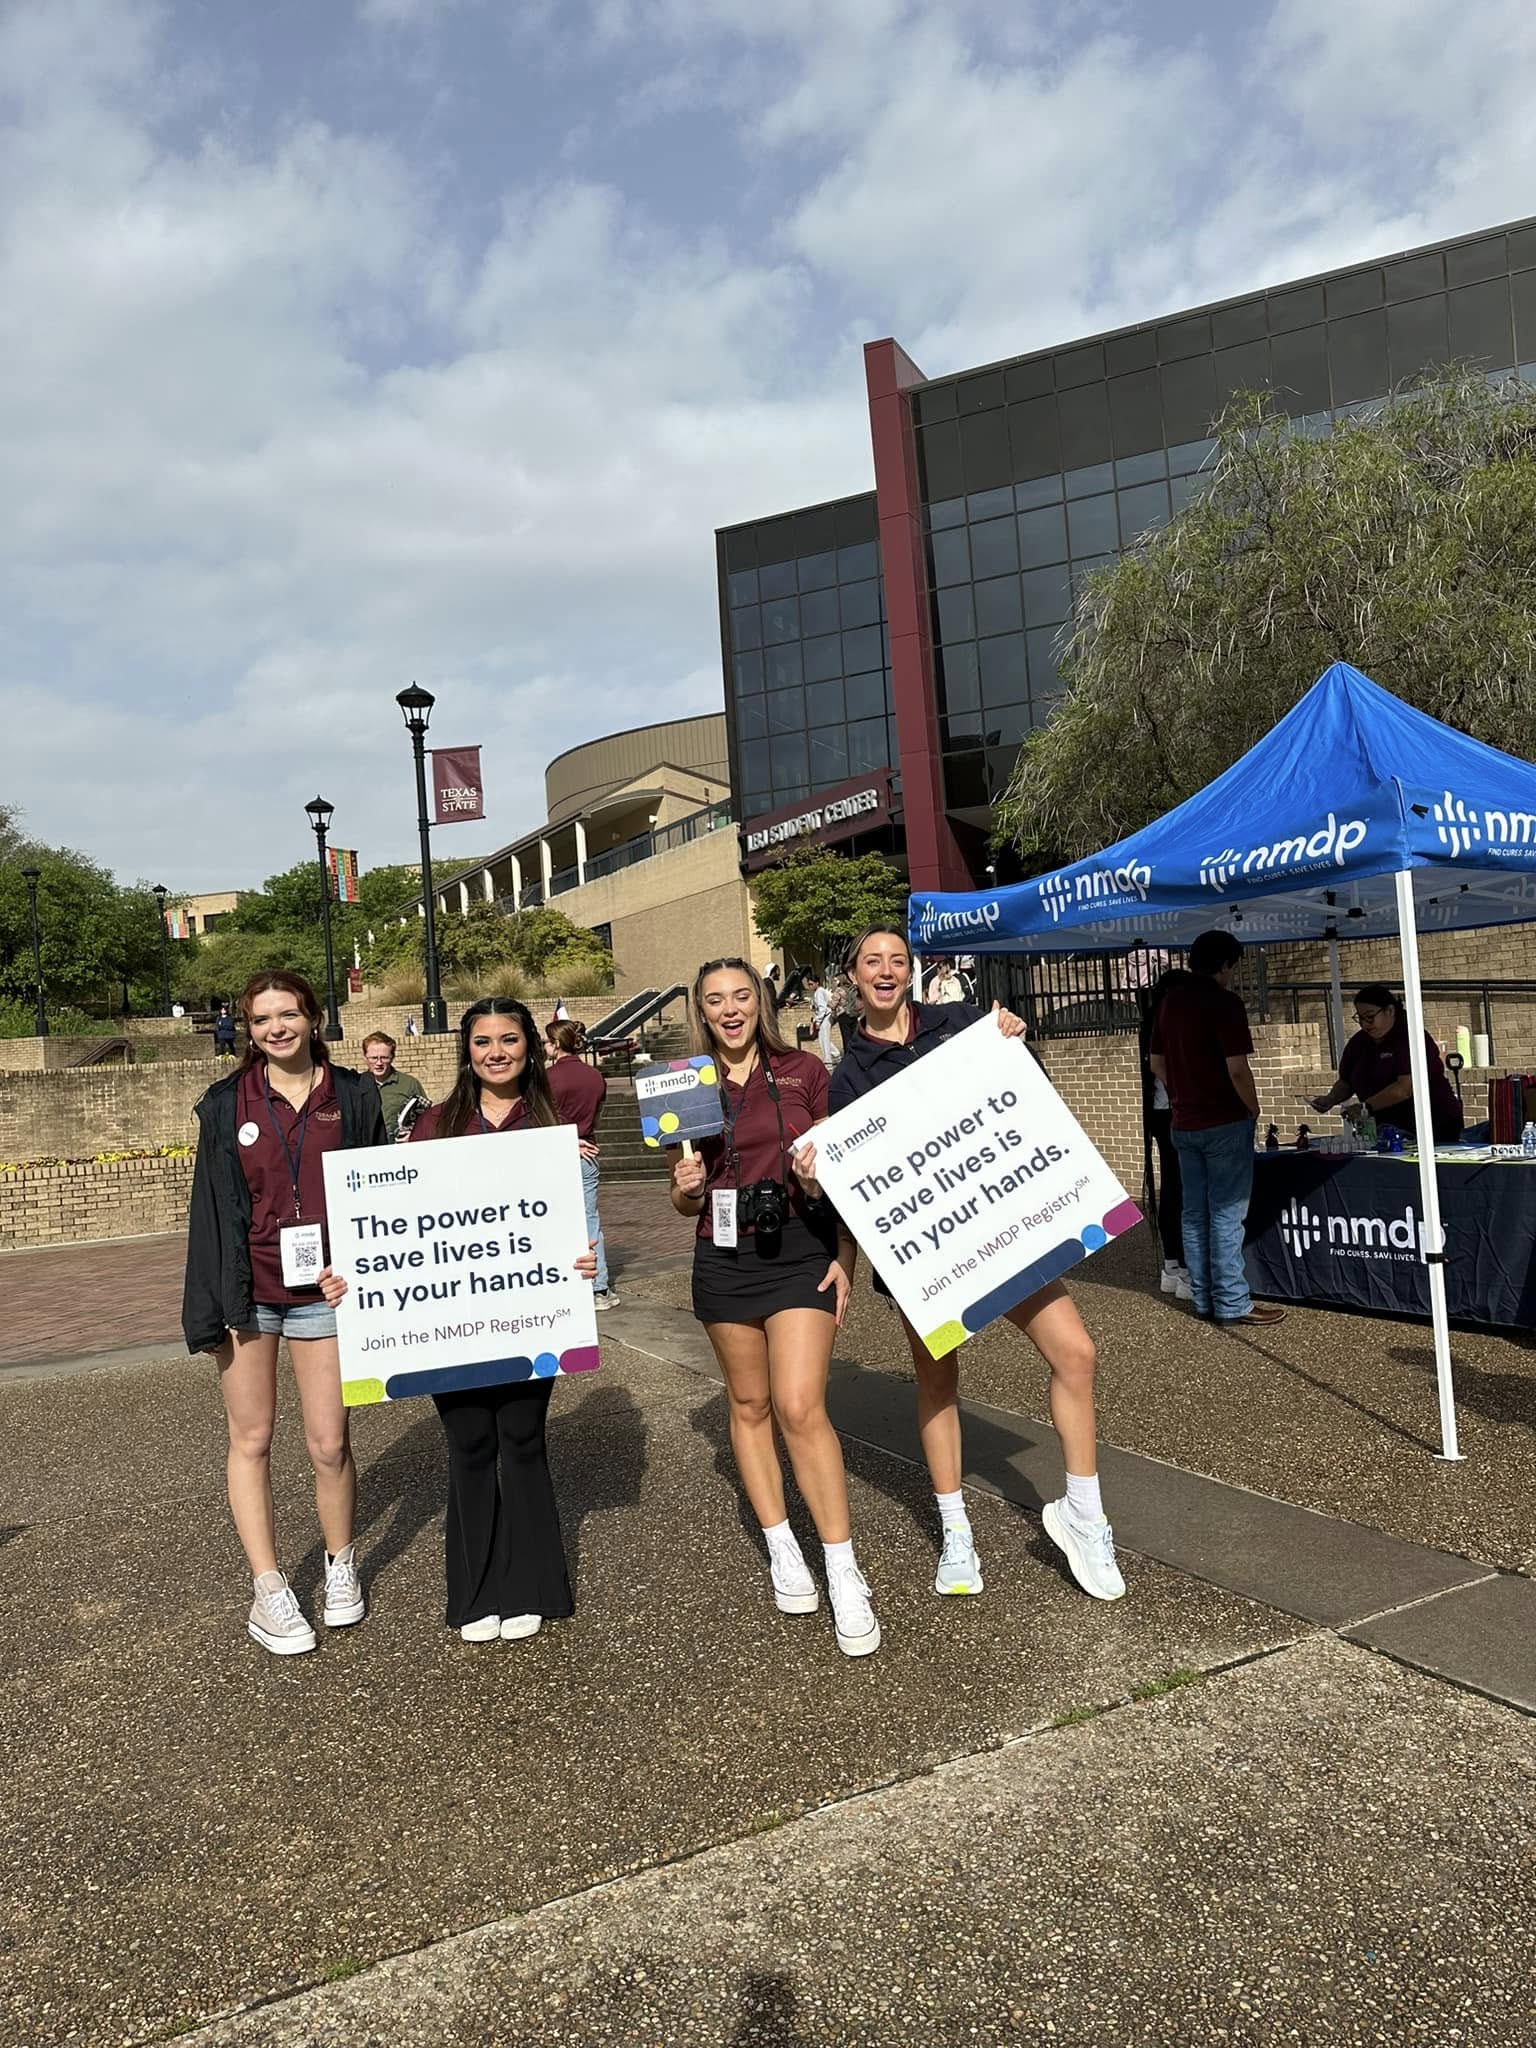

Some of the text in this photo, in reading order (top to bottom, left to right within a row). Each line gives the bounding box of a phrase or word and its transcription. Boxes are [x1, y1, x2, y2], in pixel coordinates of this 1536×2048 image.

[441, 787, 477, 798] TEXAS
[442, 801, 477, 812] STATE
[747, 789, 878, 852] LBJ STUDENT CENTER
[1243, 812, 1368, 866] nmdp
[1484, 811, 1536, 843] nm
[1075, 858, 1151, 901] nmdp
[660, 1072, 696, 1089] nmdp
[844, 1117, 886, 1148] nmdp
[851, 1166, 903, 1202] The
[907, 1109, 984, 1176] power
[988, 1091, 1017, 1114] to
[368, 1165, 418, 1184] nmdp
[875, 1130, 1021, 1233] save lives is
[351, 1199, 547, 1239] The power to
[890, 1145, 1069, 1264] in your hands.
[356, 1232, 532, 1274] save lives is
[922, 1277, 951, 1301] Join
[952, 1259, 977, 1278] the
[977, 1225, 1019, 1261] NMDP
[358, 1263, 568, 1311] in your hands.
[362, 1335, 396, 1351] Join
[402, 1331, 429, 1345] the
[435, 1322, 484, 1340] NMDP
